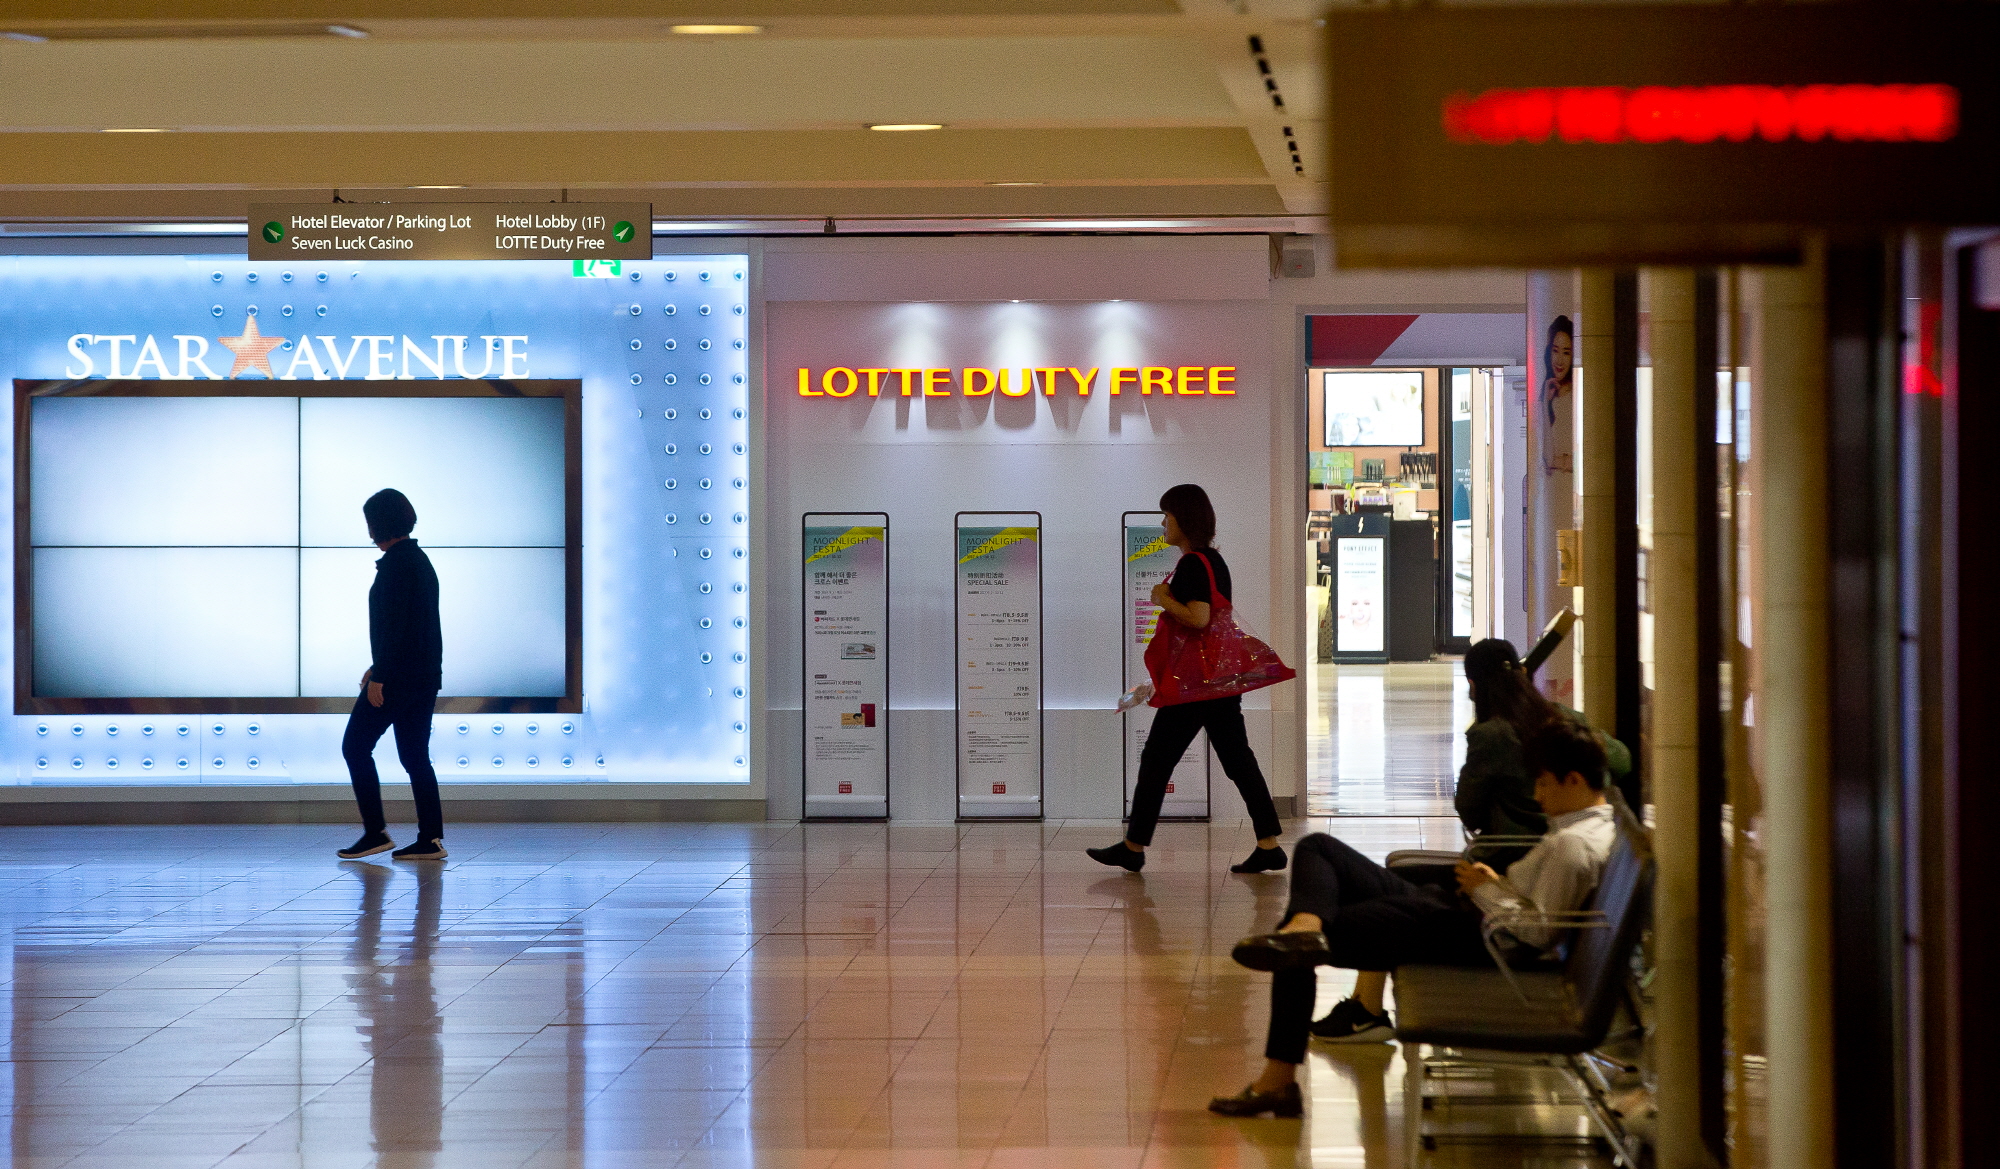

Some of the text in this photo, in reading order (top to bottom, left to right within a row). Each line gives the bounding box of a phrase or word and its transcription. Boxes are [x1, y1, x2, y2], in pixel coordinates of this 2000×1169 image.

[291, 215, 472, 232] Hotel Elevator / Parking Lot
[496, 214, 606, 232] Hotel Lobby (1F)
[291, 236, 414, 250] Seven Luck Casino
[495, 235, 605, 253] LOTTE Duty Free
[65, 333, 530, 381] STAR AVENUE
[797, 366, 1237, 397] LOTTE DUTY FREE
[813, 537, 870, 545] MOONLIGHT
[966, 537, 1024, 545] MOONLIGHT
[1134, 544, 1164, 552] FESTA
[813, 545, 842, 553] FESTA
[966, 545, 995, 553] FESTA
